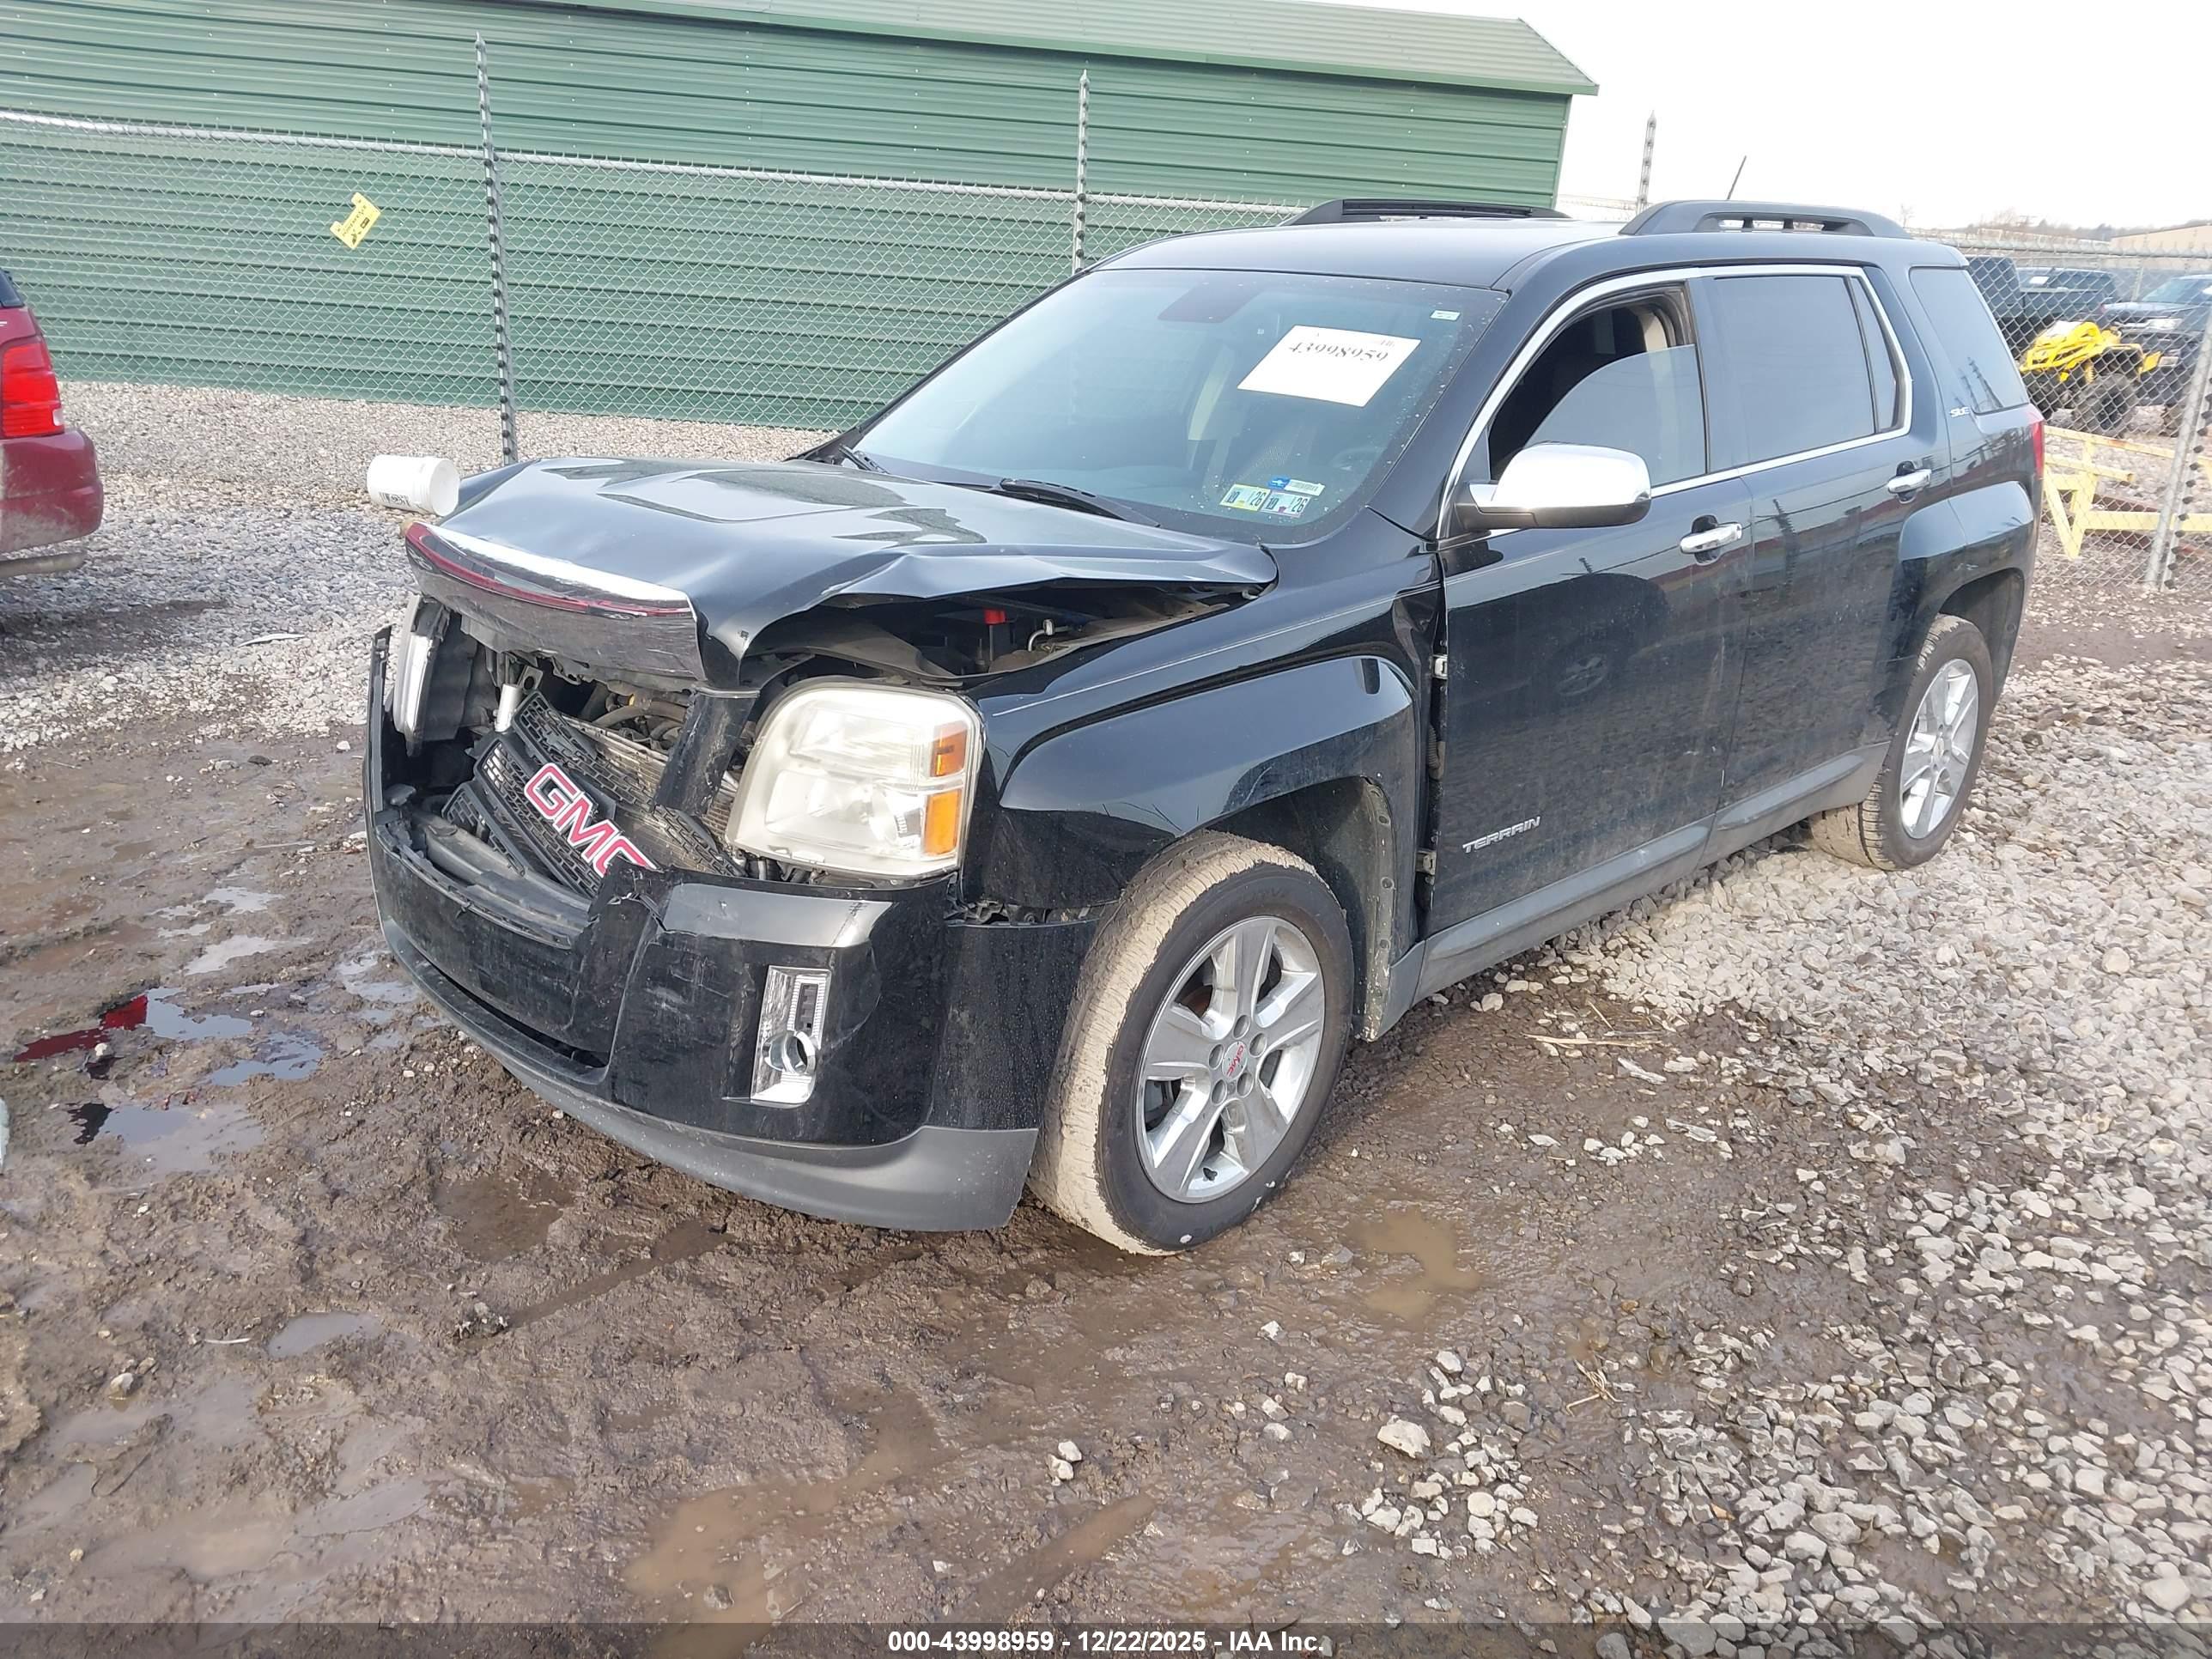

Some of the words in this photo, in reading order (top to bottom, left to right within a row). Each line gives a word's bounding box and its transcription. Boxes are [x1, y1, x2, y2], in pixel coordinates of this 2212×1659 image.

[1288, 341, 1389, 362] 43998959
[524, 763, 659, 878] GMC
[1462, 816, 1541, 854] TERRAIN
[1225, 1043, 1245, 1077] GMC
